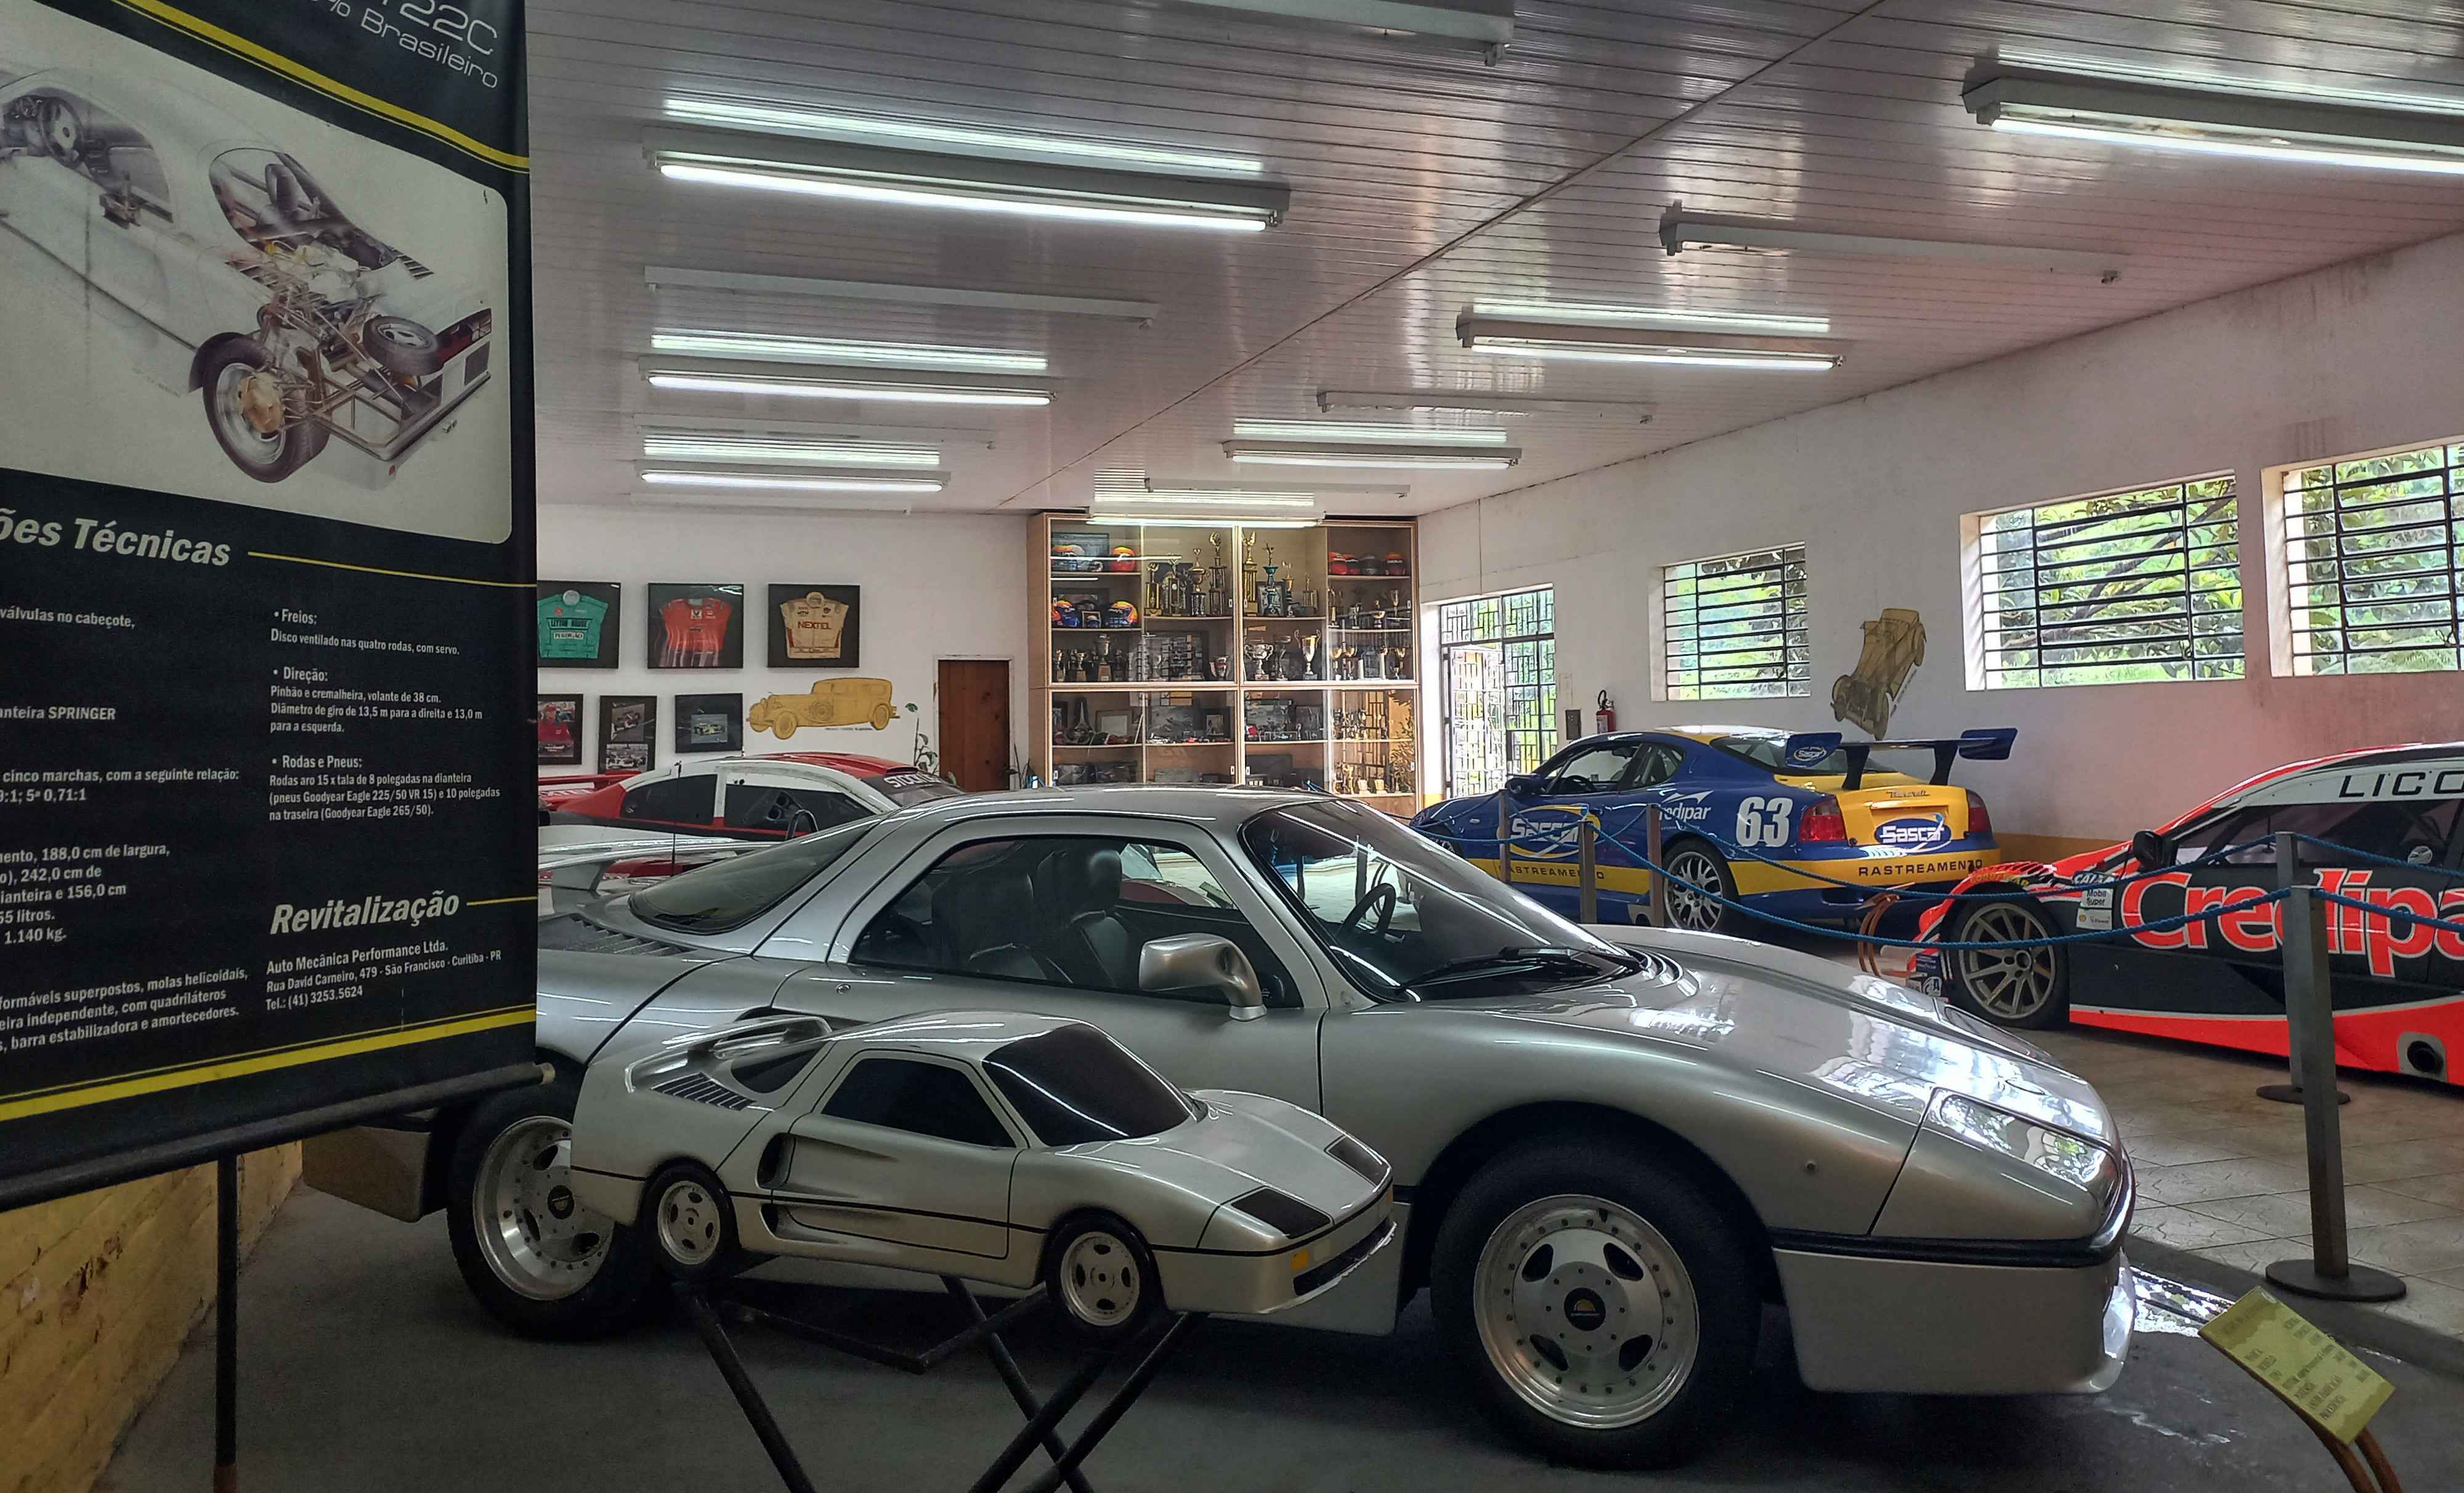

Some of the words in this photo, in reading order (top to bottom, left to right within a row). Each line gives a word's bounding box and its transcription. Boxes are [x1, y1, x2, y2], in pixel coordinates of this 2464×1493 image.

[381, 0, 498, 55] 22C
[360, 7, 498, 89] Brasileiro
[0, 508, 63, 546] ões
[74, 517, 231, 567] Técnicas
[0, 605, 54, 622] válvulas
[57, 612, 73, 623] no
[75, 612, 136, 629] cabeçote,
[798, 620, 832, 629] NEXTEL
[270, 628, 298, 643] Disco
[299, 634, 339, 647] ventilado
[341, 638, 357, 648] nas
[358, 639, 386, 651] quatro
[387, 641, 415, 653] rodas,
[416, 644, 434, 653] com
[435, 646, 460, 655] servo.
[283, 666, 328, 684] Direção:
[270, 685, 303, 698] Pinhão
[304, 689, 310, 698] e
[312, 689, 366, 703] cremalheira,
[367, 690, 399, 702] volante
[400, 691, 411, 702] de
[413, 692, 425, 703] 38
[426, 694, 442, 703] cm.
[47, 706, 116, 720] SPRINGER
[270, 702, 314, 715] Diâmetro
[314, 704, 326, 716] de
[326, 705, 344, 718] giro
[345, 705, 357, 716] de
[359, 706, 378, 719] 13,5
[379, 709, 388, 718] m
[389, 709, 410, 720] para
[411, 710, 417, 718] a
[418, 708, 445, 719] direita
[447, 710, 453, 719] e
[455, 708, 474, 720] 13,0
[474, 711, 483, 719] m
[270, 722, 292, 734] para
[293, 723, 299, 732] a
[301, 721, 345, 735] esquerda.
[282, 755, 316, 769] Rodas
[317, 758, 325, 768] e
[2, 769, 39, 783] cinco
[42, 769, 103, 783] marchas,
[105, 771, 132, 782] com
[134, 771, 142, 781] a
[144, 768, 194, 783] seguinte
[196, 767, 240, 783] relação:
[269, 774, 299, 787] Rodas
[300, 777, 315, 786] aro
[317, 774, 329, 786] 15
[330, 777, 336, 785] x
[337, 774, 355, 785] tala
[356, 774, 367, 785] de
[369, 774, 375, 785] 8
[376, 773, 421, 787] polegadas
[422, 775, 433, 784] na
[434, 772, 472, 783] dianteira
[269, 792, 301, 806] (pneus
[303, 791, 346, 804] Goodyear
[346, 790, 371, 803] Eagle
[371, 789, 407, 803] 225/50
[408, 788, 420, 799] VR
[422, 788, 437, 801] 15)
[446, 788, 457, 799] 10
[458, 787, 501, 801] polegadas
[269, 811, 282, 821] na
[283, 809, 319, 820] traseira
[320, 807, 366, 822] (Goodyear
[367, 806, 391, 819] Eagle
[1658, 802, 1712, 823] redipar
[1736, 796, 1793, 848] 63
[1879, 825, 1945, 844] Sascar
[41, 846, 81, 862] 188,0
[83, 848, 102, 859] cm
[105, 845, 121, 857] de
[123, 844, 171, 859] largura,
[20, 867, 61, 883] 242,0
[63, 869, 83, 880] cm
[86, 865, 102, 878] de
[1499, 865, 1604, 880] STREAMEO
[0, 888, 52, 904] ianteira
[55, 889, 63, 900] e
[67, 883, 105, 899] 156,0
[107, 884, 127, 896] cm
[16, 908, 55, 923] litros.
[270, 889, 460, 935] Revitalização
[4, 928, 44, 945] 1.140
[266, 960, 293, 975] Auto
[296, 952, 349, 971] Mecânica
[352, 945, 421, 963] Performance
[423, 939, 448, 953] Ltda.
[266, 981, 285, 993] Rua
[287, 975, 313, 990] David
[315, 970, 358, 985] Carneiro,
[359, 966, 378, 979] 479
[384, 963, 403, 976] São
[404, 958, 445, 973] Francisco
[452, 953, 484, 966] Curitiba
[490, 950, 501, 961] PR
[0, 990, 61, 1010] formáveis
[63, 982, 144, 1003] superpostos,
[147, 976, 183, 992] molas
[185, 967, 248, 986] helicoidais,
[26, 1008, 119, 1028] independente,
[121, 1001, 147, 1013] com
[150, 989, 227, 1012] quadriláteros
[288, 993, 309, 1010] (41)
[11, 1034, 46, 1050] barra
[48, 1020, 139, 1044] estabilizadora
[140, 1019, 149, 1030] e
[151, 1005, 240, 1029] amortecedores.
